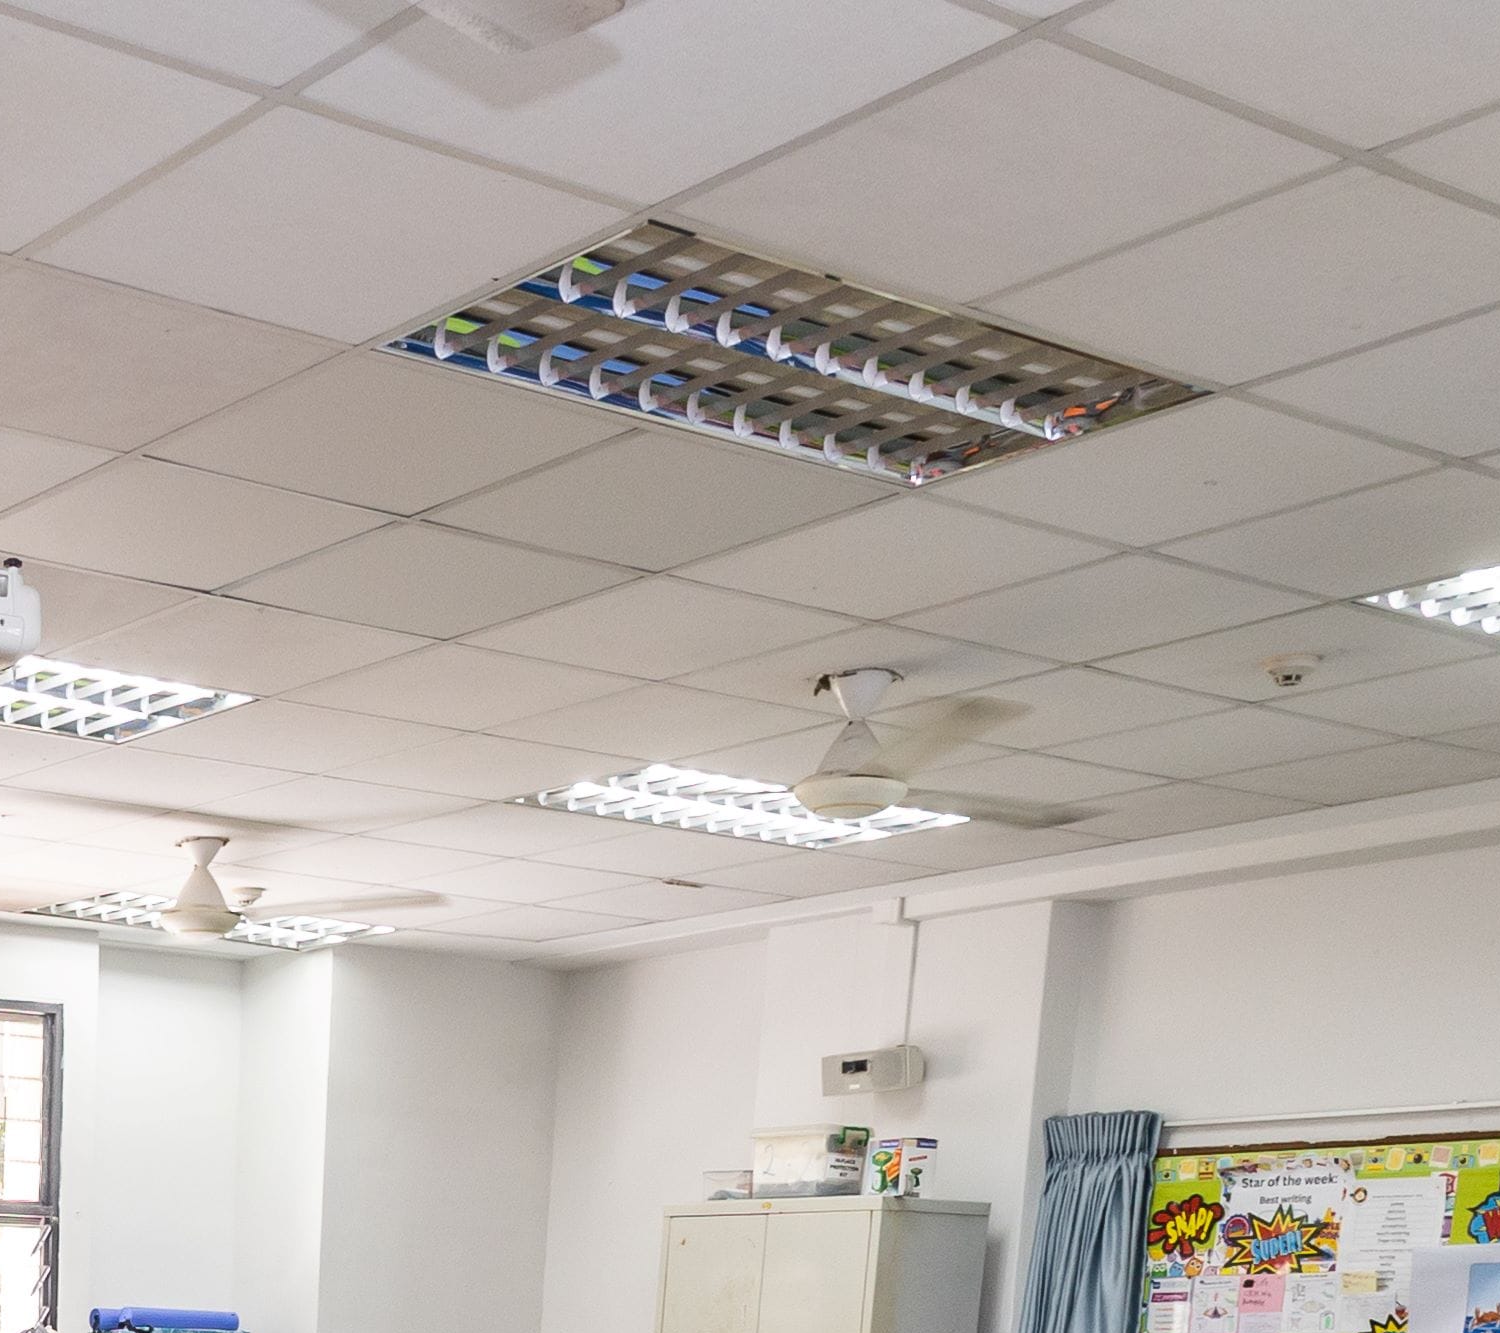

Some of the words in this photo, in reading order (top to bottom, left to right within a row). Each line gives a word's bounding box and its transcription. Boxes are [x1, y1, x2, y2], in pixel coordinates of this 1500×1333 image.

[1242, 1175, 1263, 1188] Star
[1269, 1174, 1281, 1187] of
[1283, 1174, 1301, 1187] the
[1260, 1195, 1278, 1205] Best
[1281, 1194, 1312, 1206] writing
[1167, 1207, 1214, 1244] SNAP!
[1252, 1230, 1302, 1264] SUPER!
